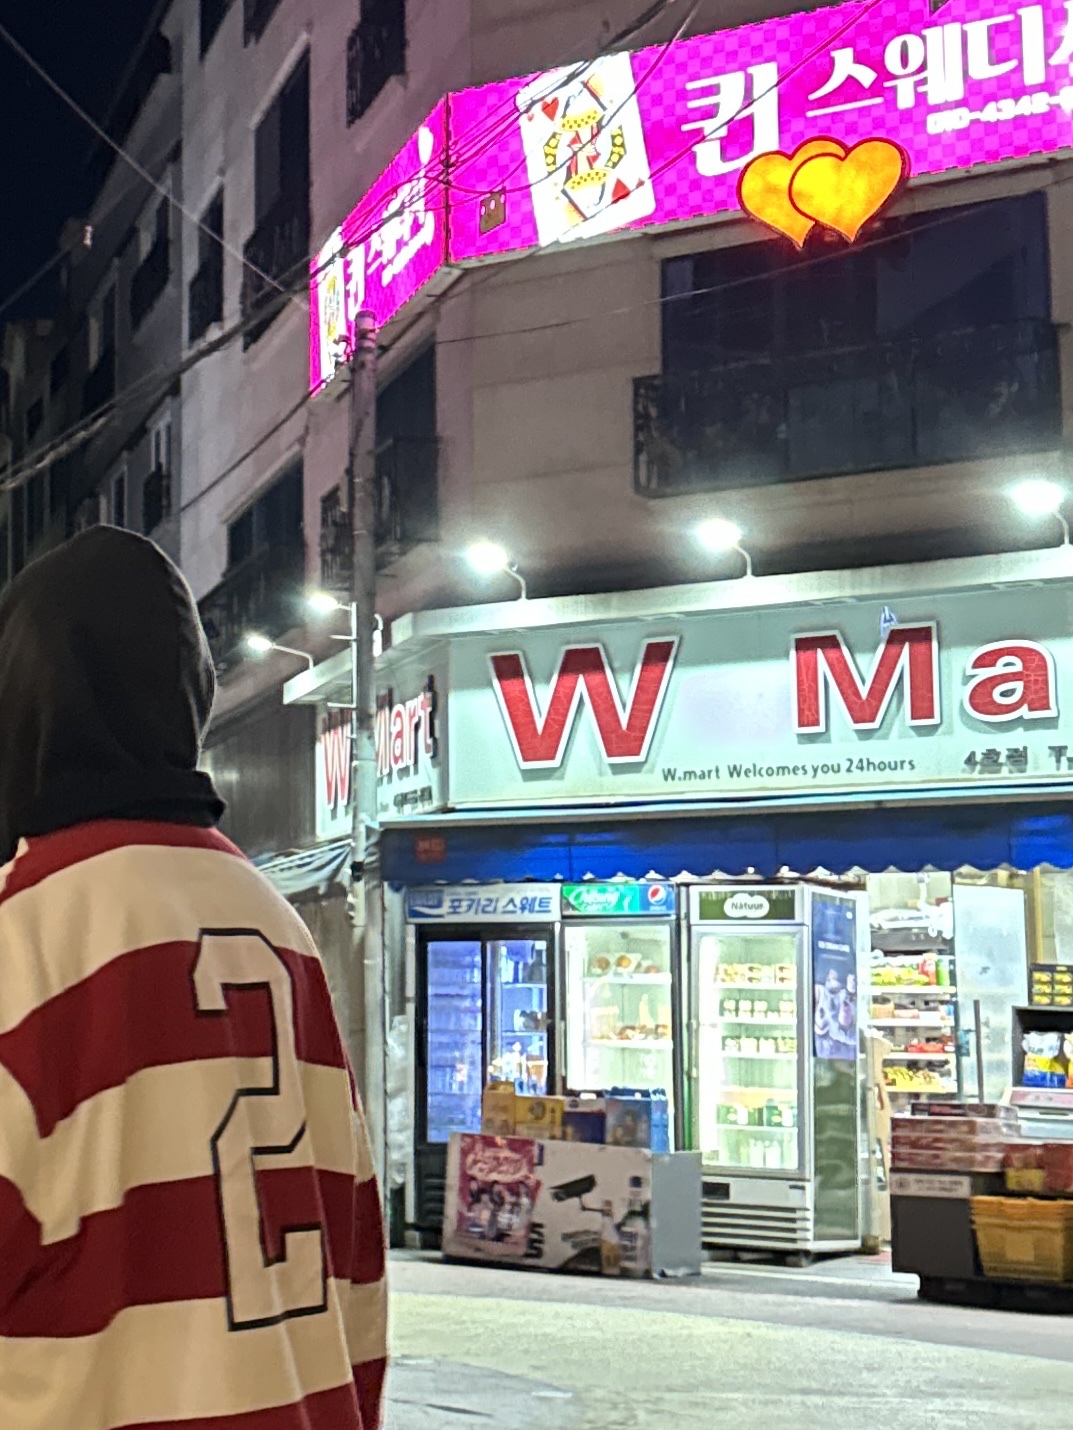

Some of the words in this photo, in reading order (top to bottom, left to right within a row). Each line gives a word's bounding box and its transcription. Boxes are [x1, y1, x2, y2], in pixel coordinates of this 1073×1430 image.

[488, 635, 680, 770] W
[662, 767, 721, 782] W.mart
[727, 762, 809, 779] Welcomes
[811, 762, 842, 778] you
[845, 757, 916, 773] 24hours
[446, 897, 499, 915] 포카리
[501, 895, 553, 915] 스웨트
